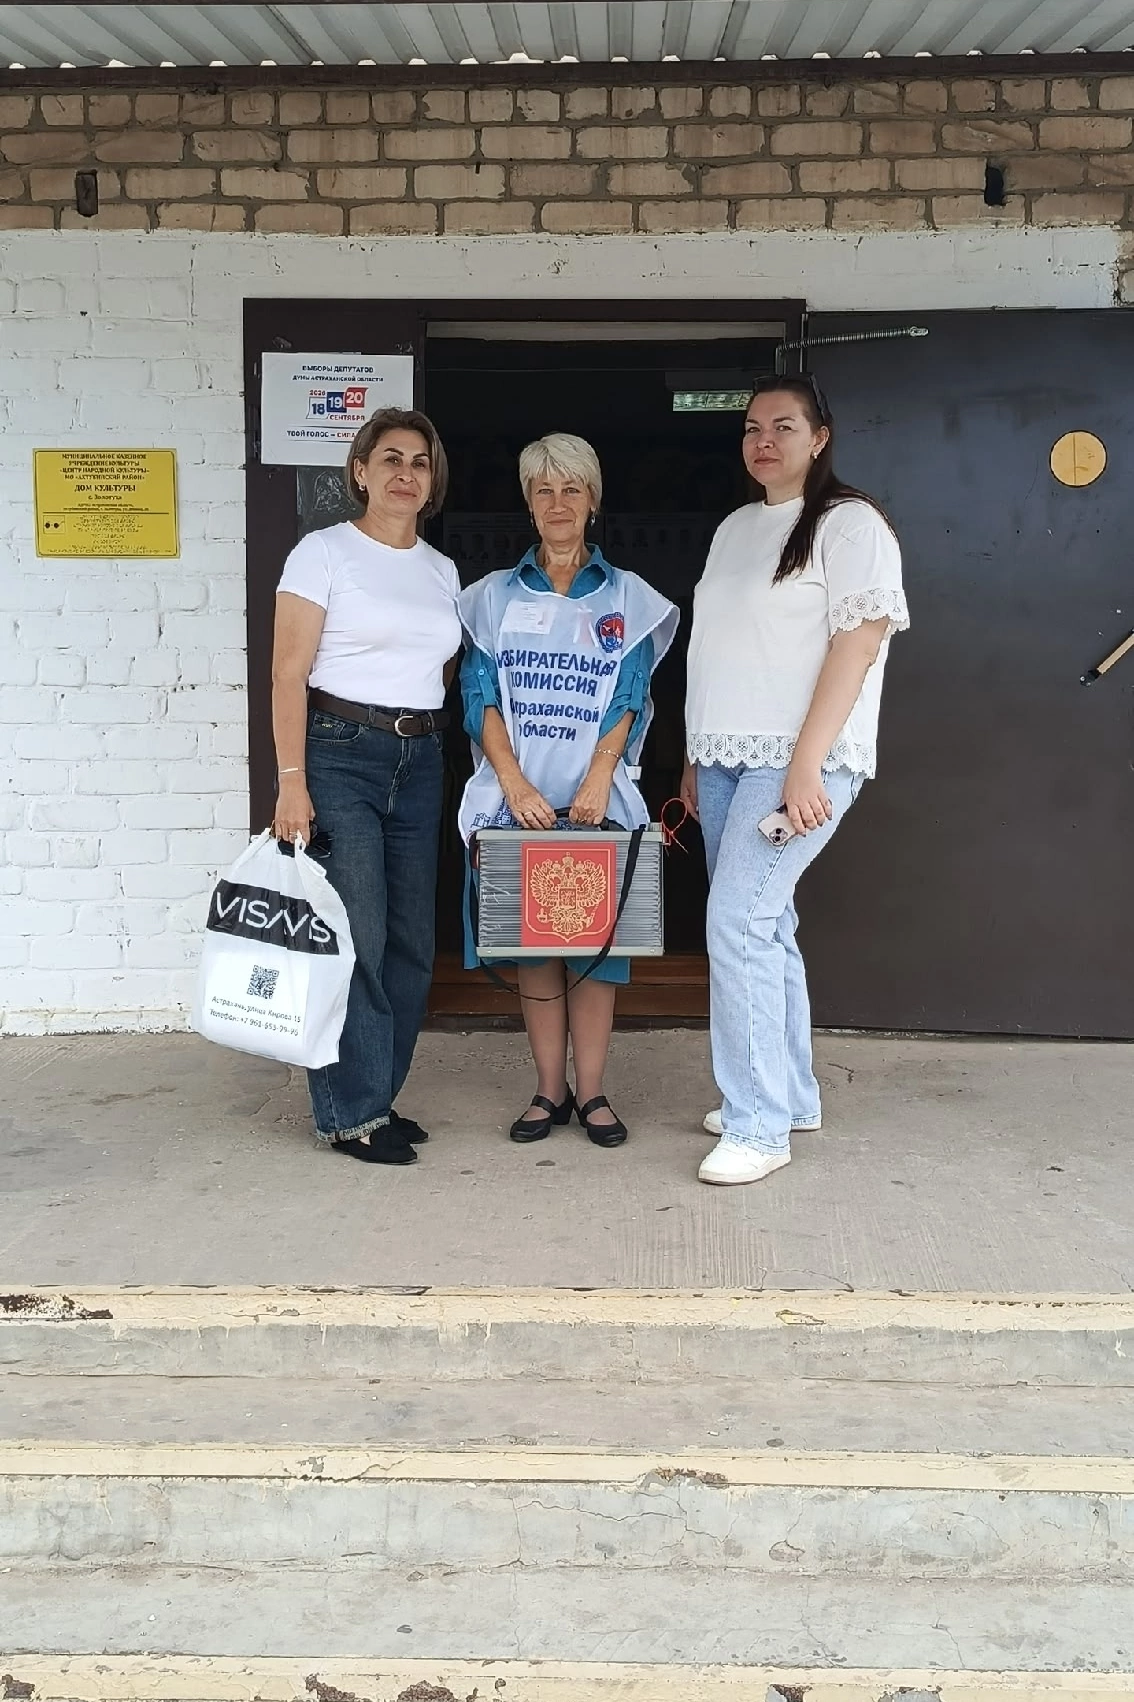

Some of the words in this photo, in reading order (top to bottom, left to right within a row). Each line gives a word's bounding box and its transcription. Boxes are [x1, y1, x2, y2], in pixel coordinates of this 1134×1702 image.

[312, 403, 325, 415] 18
[329, 397, 342, 408] 19
[346, 392, 363, 403] 20
[287, 429, 306, 437] ТВОЙ
[496, 649, 618, 677] ИЗБИРАТЕЛЬНАЯ
[510, 698, 599, 723] траханской
[519, 720, 577, 741] бласти
[209, 1008, 239, 1022] Телефон:
[294, 1015, 301, 1023] 15
